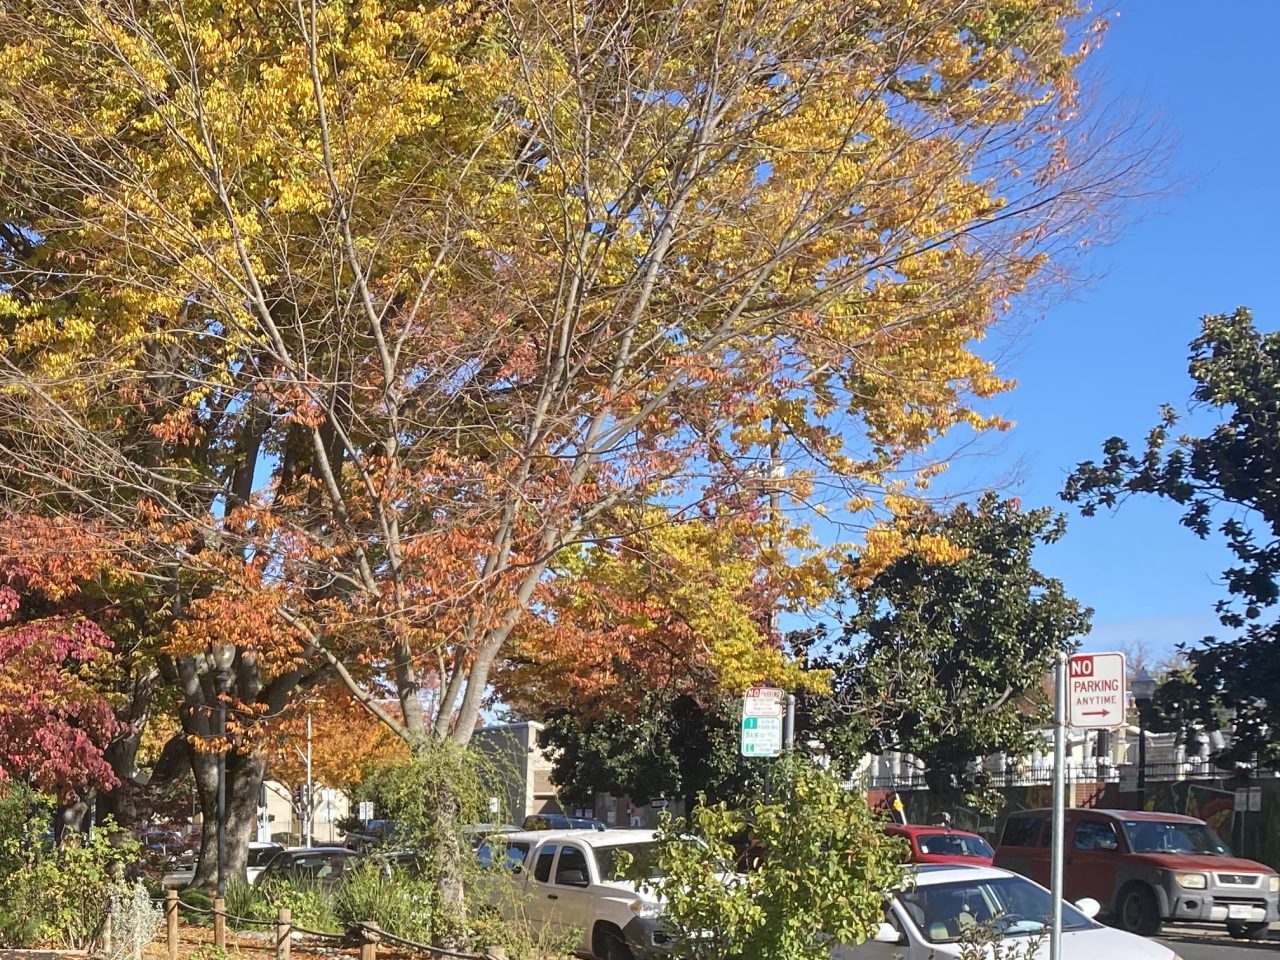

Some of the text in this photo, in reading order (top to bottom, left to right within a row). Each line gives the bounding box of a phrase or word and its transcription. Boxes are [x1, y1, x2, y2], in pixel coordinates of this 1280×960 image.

[1072, 660, 1092, 675] NO
[1074, 679, 1118, 692] PARKING
[1076, 696, 1117, 705] ANYTIME
